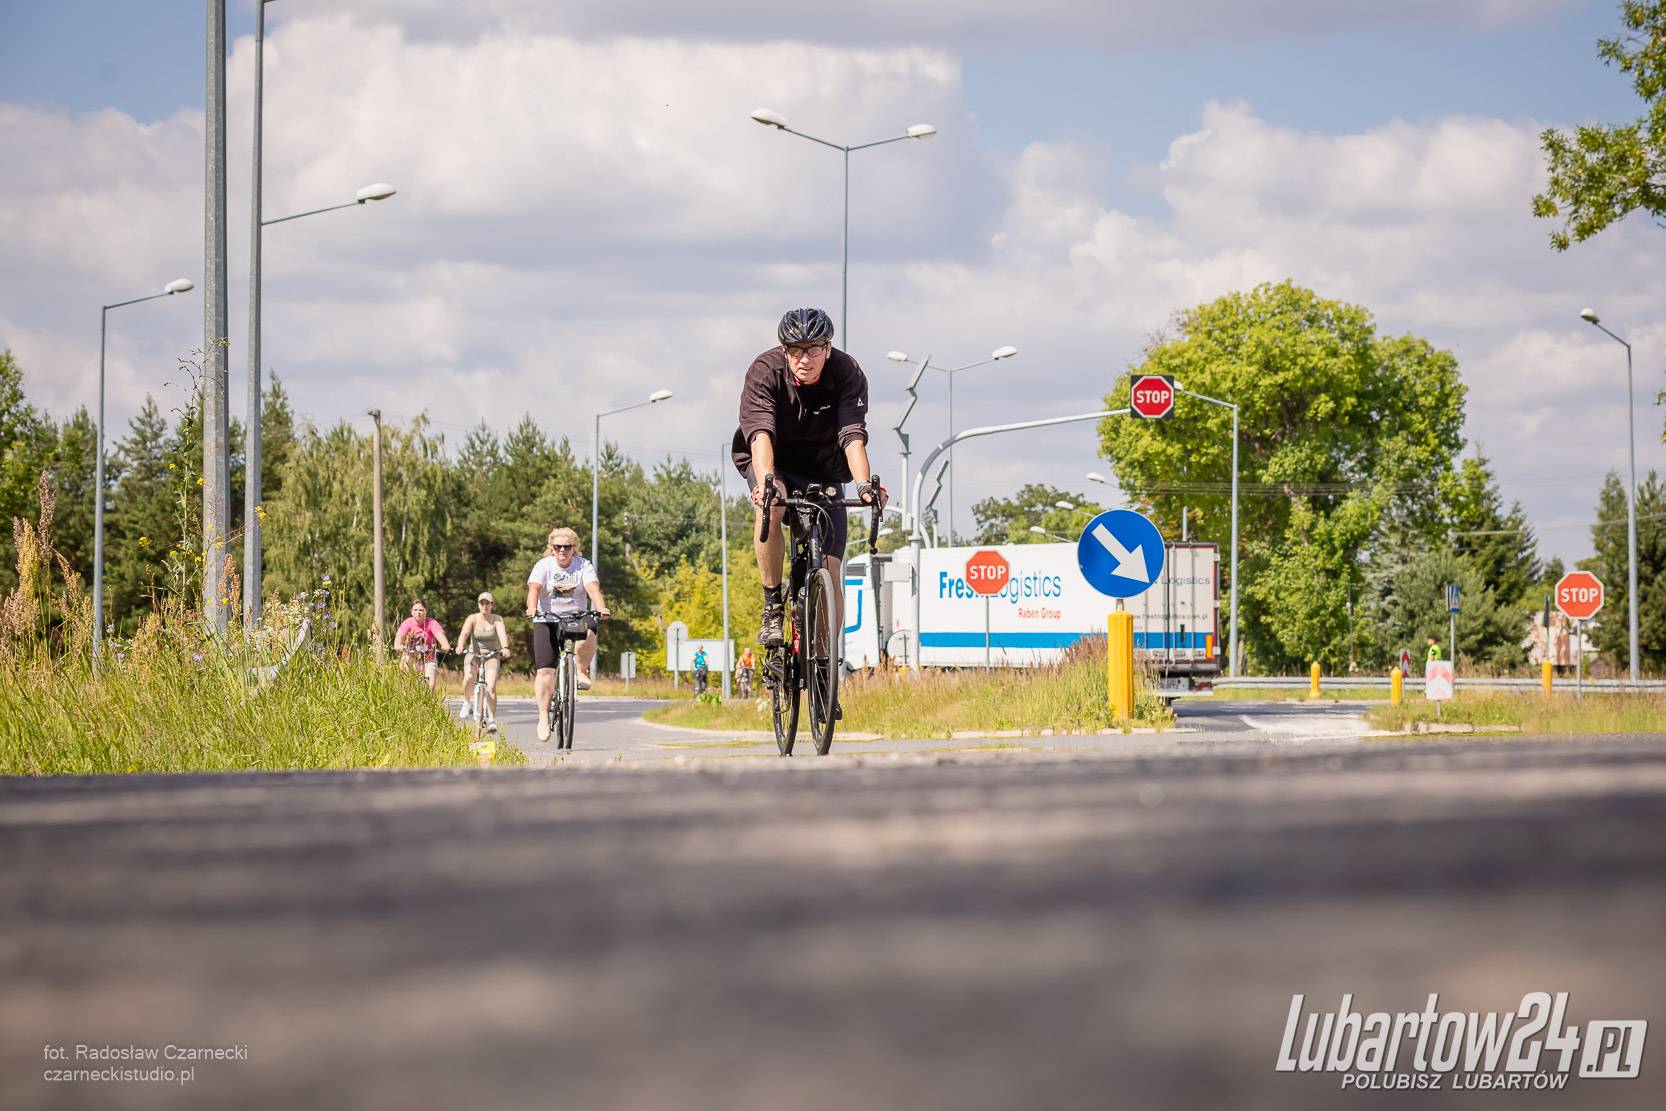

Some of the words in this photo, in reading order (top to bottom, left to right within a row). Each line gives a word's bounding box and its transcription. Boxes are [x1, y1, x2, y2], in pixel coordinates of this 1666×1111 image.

[1136, 390, 1170, 404] STOP
[969, 565, 1007, 580] STOP
[939, 570, 984, 599] Fres
[990, 569, 1062, 604] ogistics
[1560, 588, 1599, 603] STOP
[1018, 608, 1039, 619] Raben
[1041, 608, 1062, 621] Group
